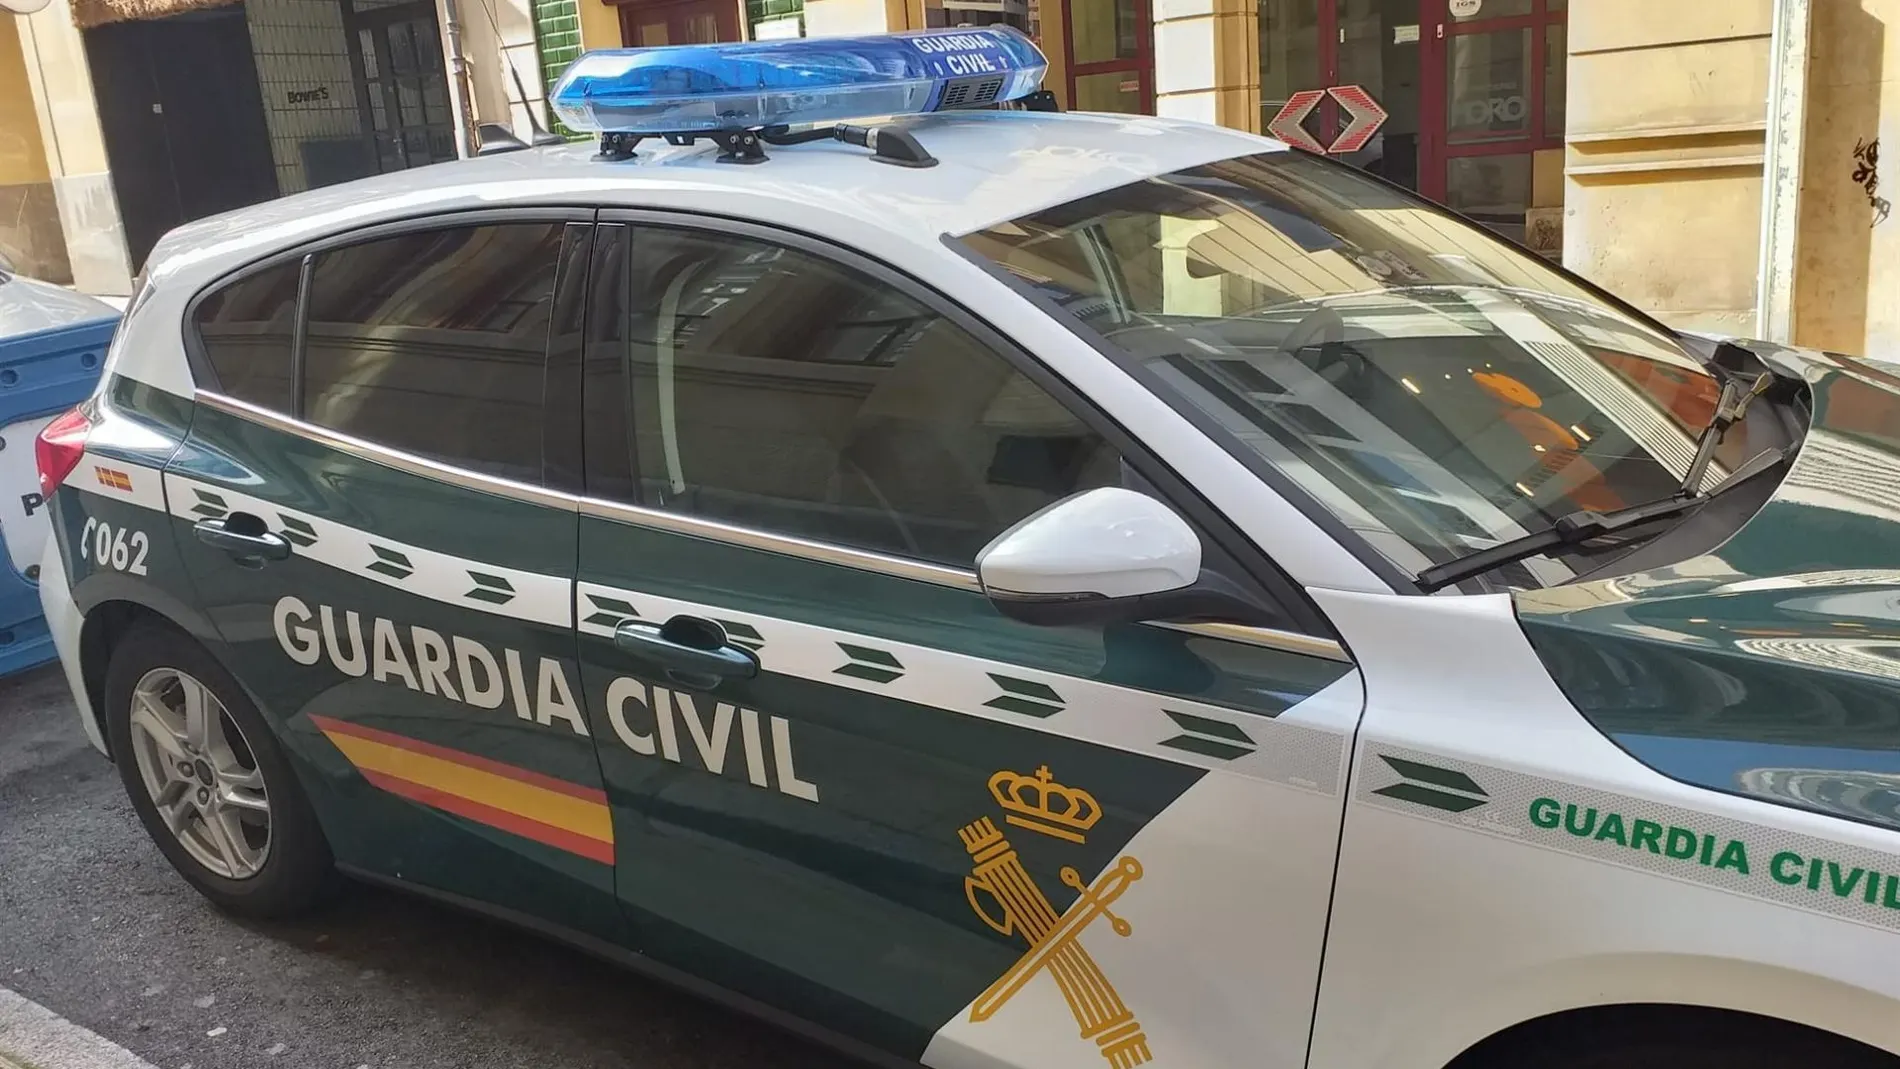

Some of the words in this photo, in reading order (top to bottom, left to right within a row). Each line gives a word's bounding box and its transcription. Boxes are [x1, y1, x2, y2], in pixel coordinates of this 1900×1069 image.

[912, 34, 995, 54] GUARDIA
[946, 53, 996, 75] CIVIL
[95, 522, 149, 577] 062
[273, 596, 591, 737] GUARDIA
[606, 677, 820, 803] CIVIL
[1528, 797, 1750, 875] GUARDIA
[1769, 851, 1900, 911] CIVIL
